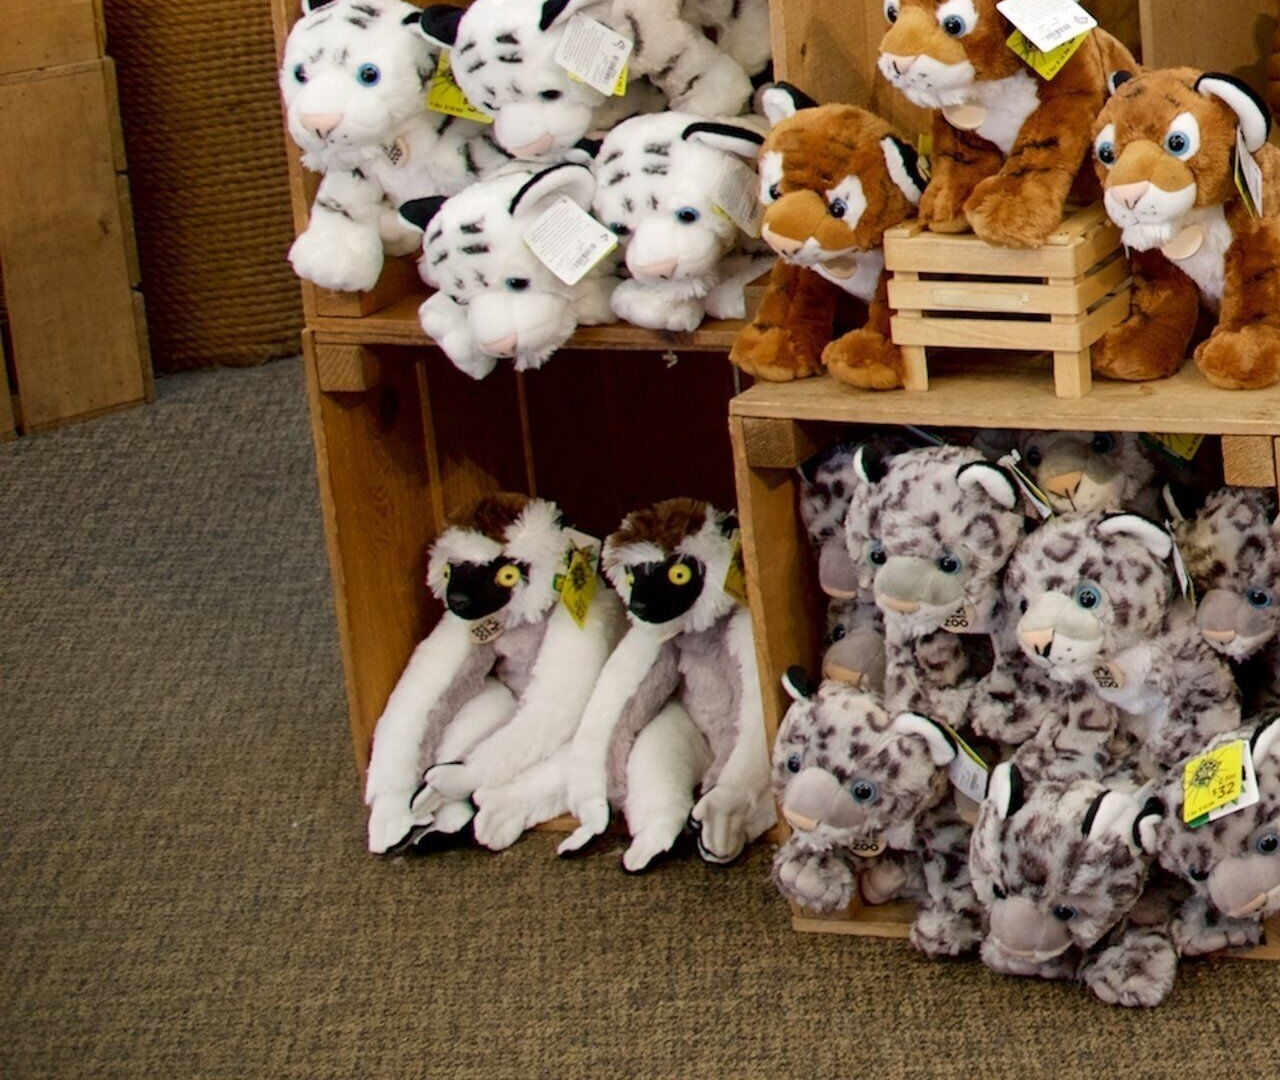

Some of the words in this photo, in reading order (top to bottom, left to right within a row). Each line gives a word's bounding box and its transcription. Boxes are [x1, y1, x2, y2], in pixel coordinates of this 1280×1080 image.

[944, 619, 968, 627] ZOO
[1212, 782, 1235, 799] $32
[853, 842, 879, 851] ZOO
